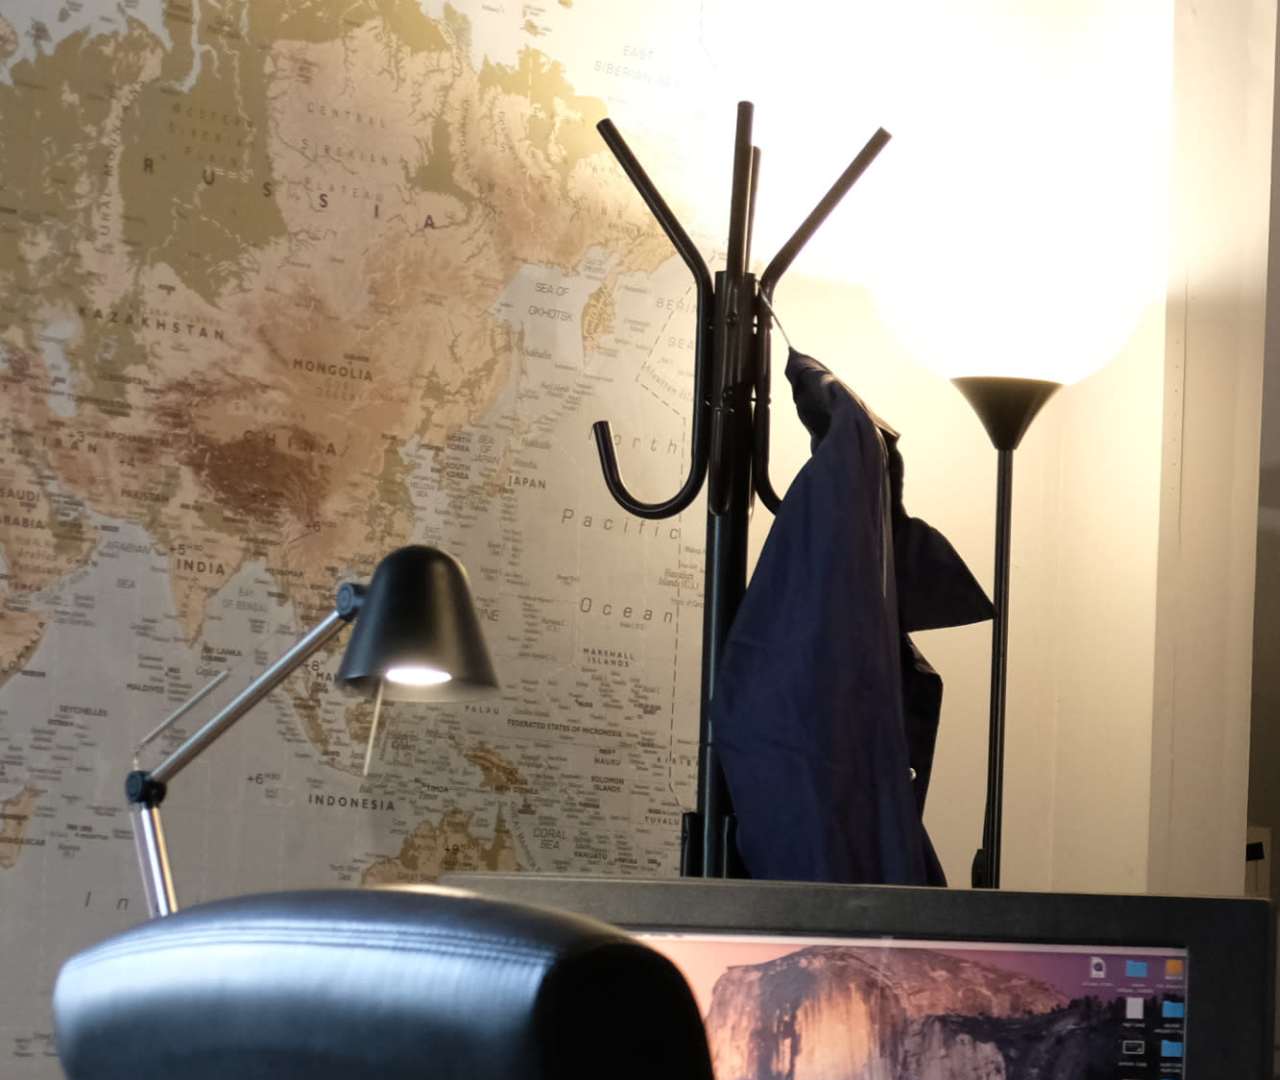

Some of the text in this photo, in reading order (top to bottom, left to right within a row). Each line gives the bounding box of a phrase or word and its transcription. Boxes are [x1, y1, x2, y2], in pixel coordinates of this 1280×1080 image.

[143, 157, 435, 230] RUSSIA
[535, 282, 569, 297] SEA OF
[528, 305, 574, 322] OKHOTSK
[77, 306, 225, 342] KAZAKHSTAN
[293, 358, 374, 382] MONGOLIA
[42, 436, 97, 454] IRAN
[243, 430, 337, 457] CHINA
[446, 471, 469, 480] KOREA
[508, 475, 547, 489] JAPAN
[0, 487, 40, 502] SAUDI
[0, 515, 46, 530] RABIA
[561, 508, 680, 541] Pacific
[176, 559, 225, 576] INDIA
[579, 597, 672, 624] Ocean
[583, 648, 635, 661] MARSHALL
[464, 705, 499, 715] PALAU
[507, 719, 545, 730] FEDERATED
[591, 775, 624, 785] SOLOMON
[308, 794, 395, 811] INDONESIA
[645, 815, 680, 826] TUVALU
[533, 827, 568, 840] CORAL
[540, 840, 560, 850] SEA
